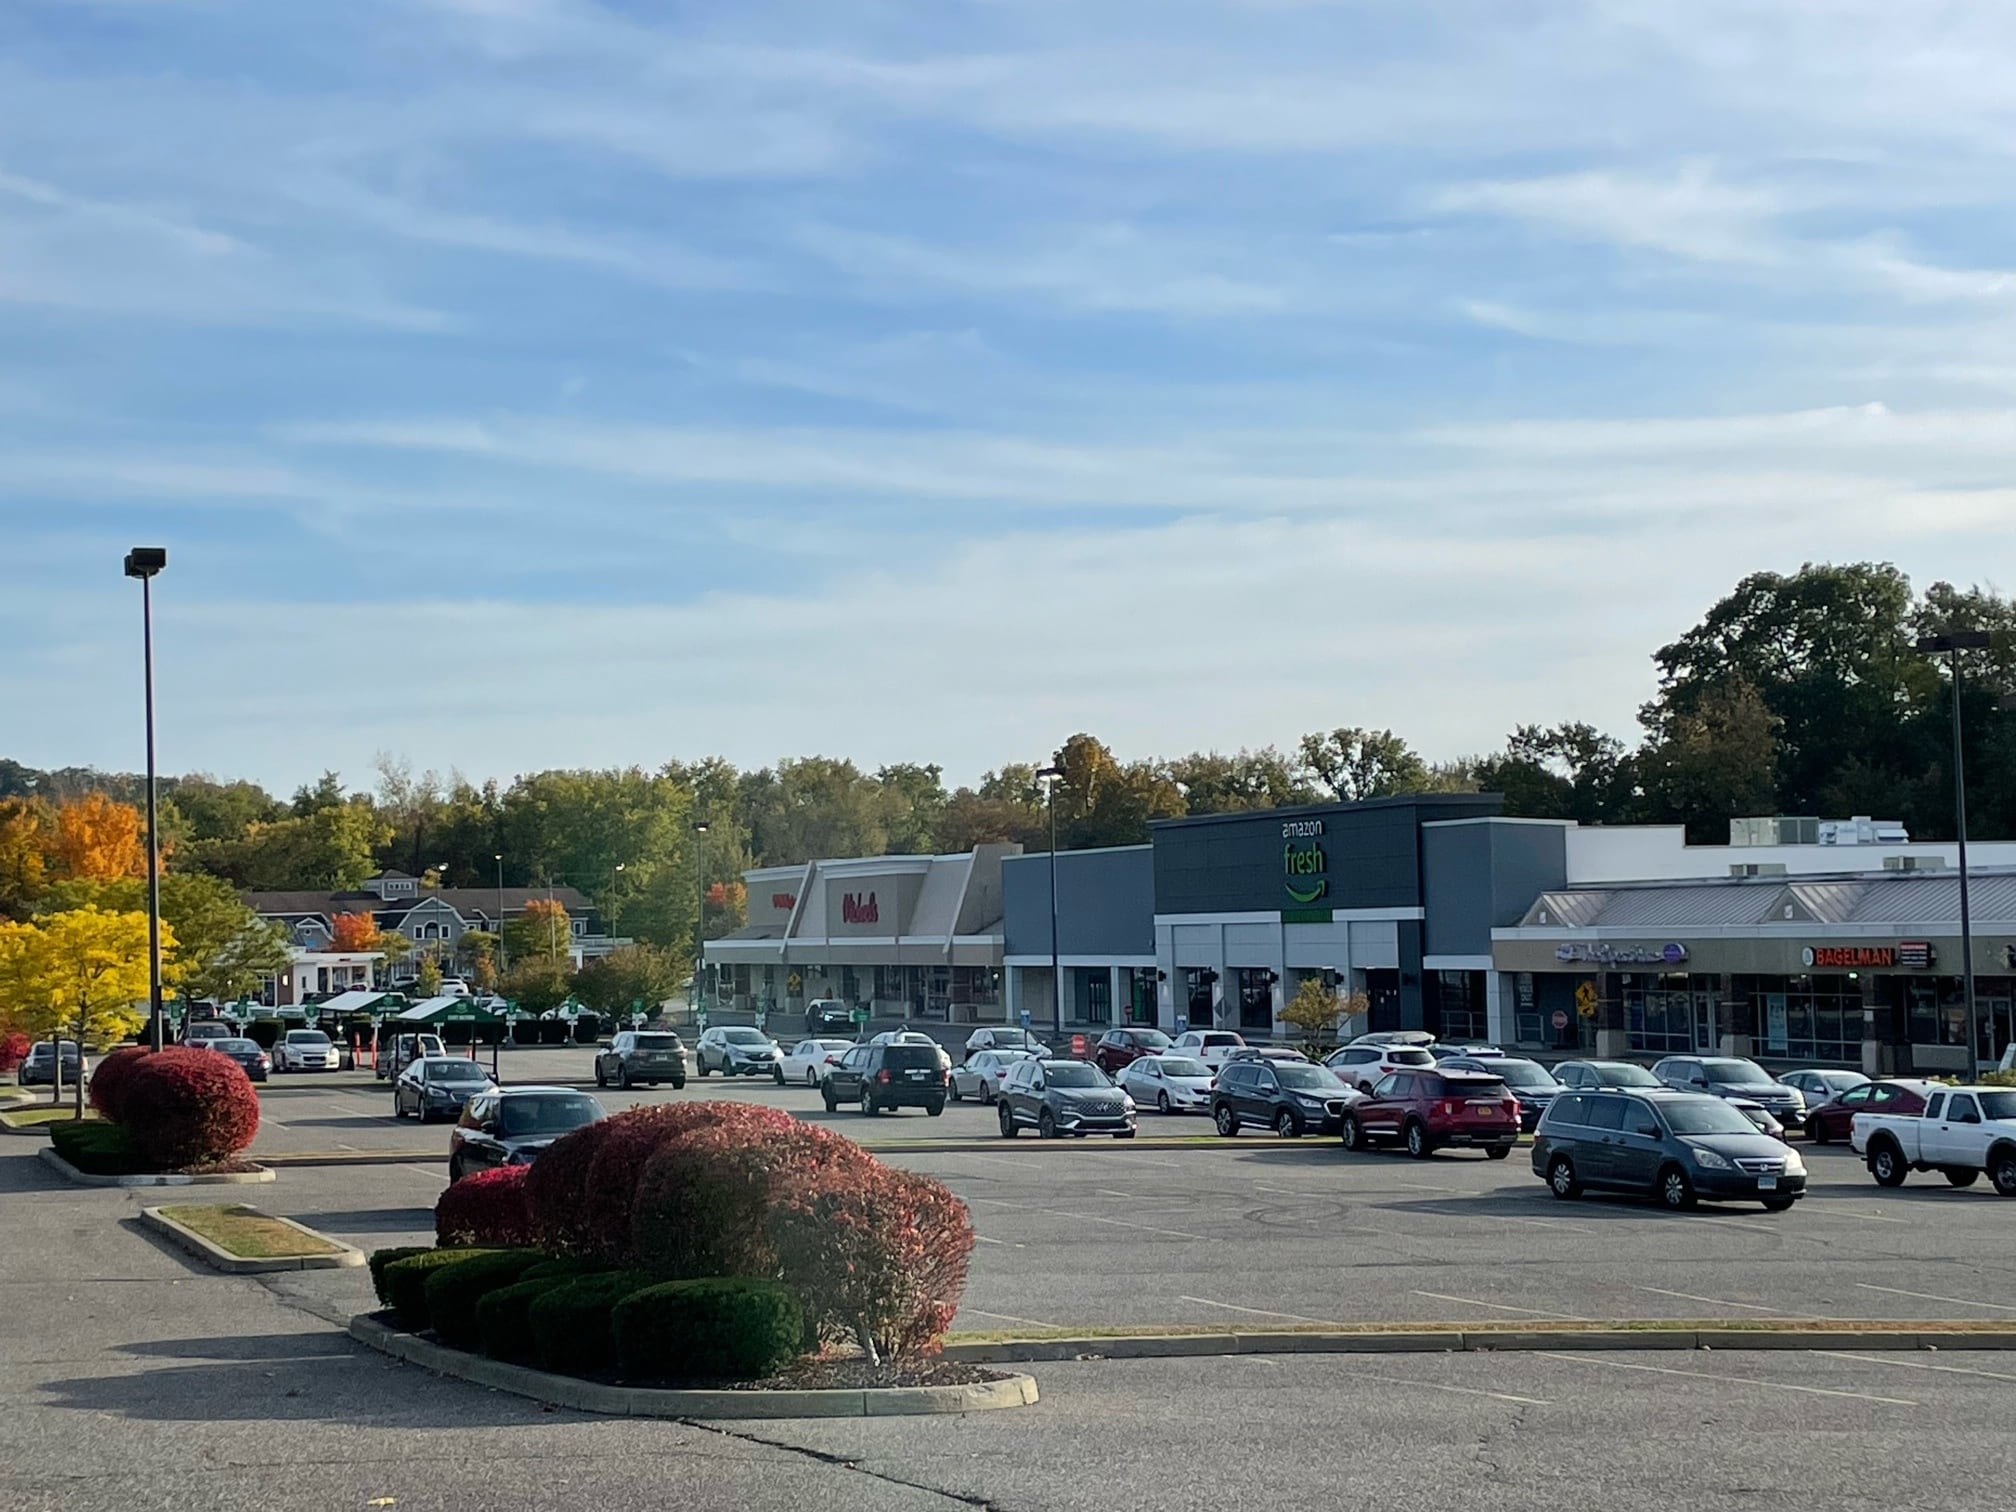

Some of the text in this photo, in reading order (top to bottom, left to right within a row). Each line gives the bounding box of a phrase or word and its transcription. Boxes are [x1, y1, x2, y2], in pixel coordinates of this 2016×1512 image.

[1282, 820, 1322, 838] amazon
[1284, 842, 1323, 874] fresh
[1816, 948, 1893, 966] BAGELMAN
